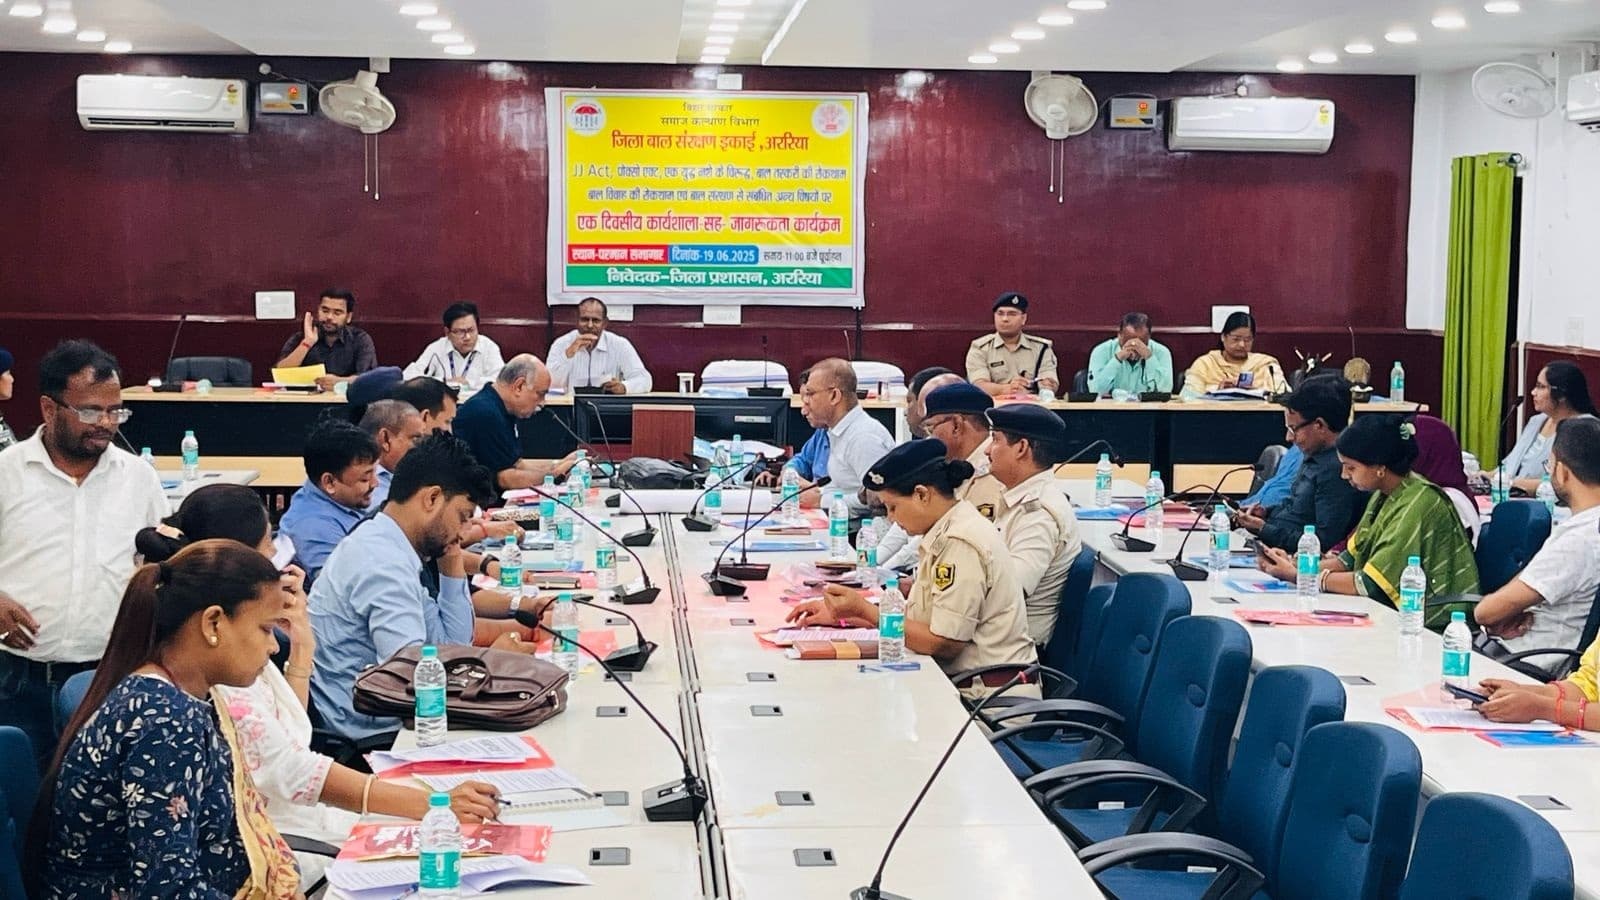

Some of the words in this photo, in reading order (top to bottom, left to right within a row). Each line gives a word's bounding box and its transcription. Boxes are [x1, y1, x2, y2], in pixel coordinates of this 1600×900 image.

[660, 116, 688, 126] समाज
[691, 116, 727, 126] कल्याण
[730, 115, 760, 126] विभाग
[612, 130, 643, 149] जिला
[675, 130, 717, 150] संरक्षण
[719, 131, 756, 152] इकाई
[573, 164, 584, 177] JJ
[588, 164, 614, 179] Act,
[588, 189, 603, 201] बाल
[606, 187, 627, 201] विवाह
[629, 187, 641, 201] की
[776, 191, 795, 202] अन्य
[821, 191, 832, 203] पर
[577, 215, 597, 231] एक
[601, 210, 643, 231] दिवसीय
[730, 215, 790, 232] जागरूकता
[793, 212, 841, 233] कार्यक्रम
[709, 271, 768, 286] प्रशासन,
[771, 269, 823, 286] अररिया
